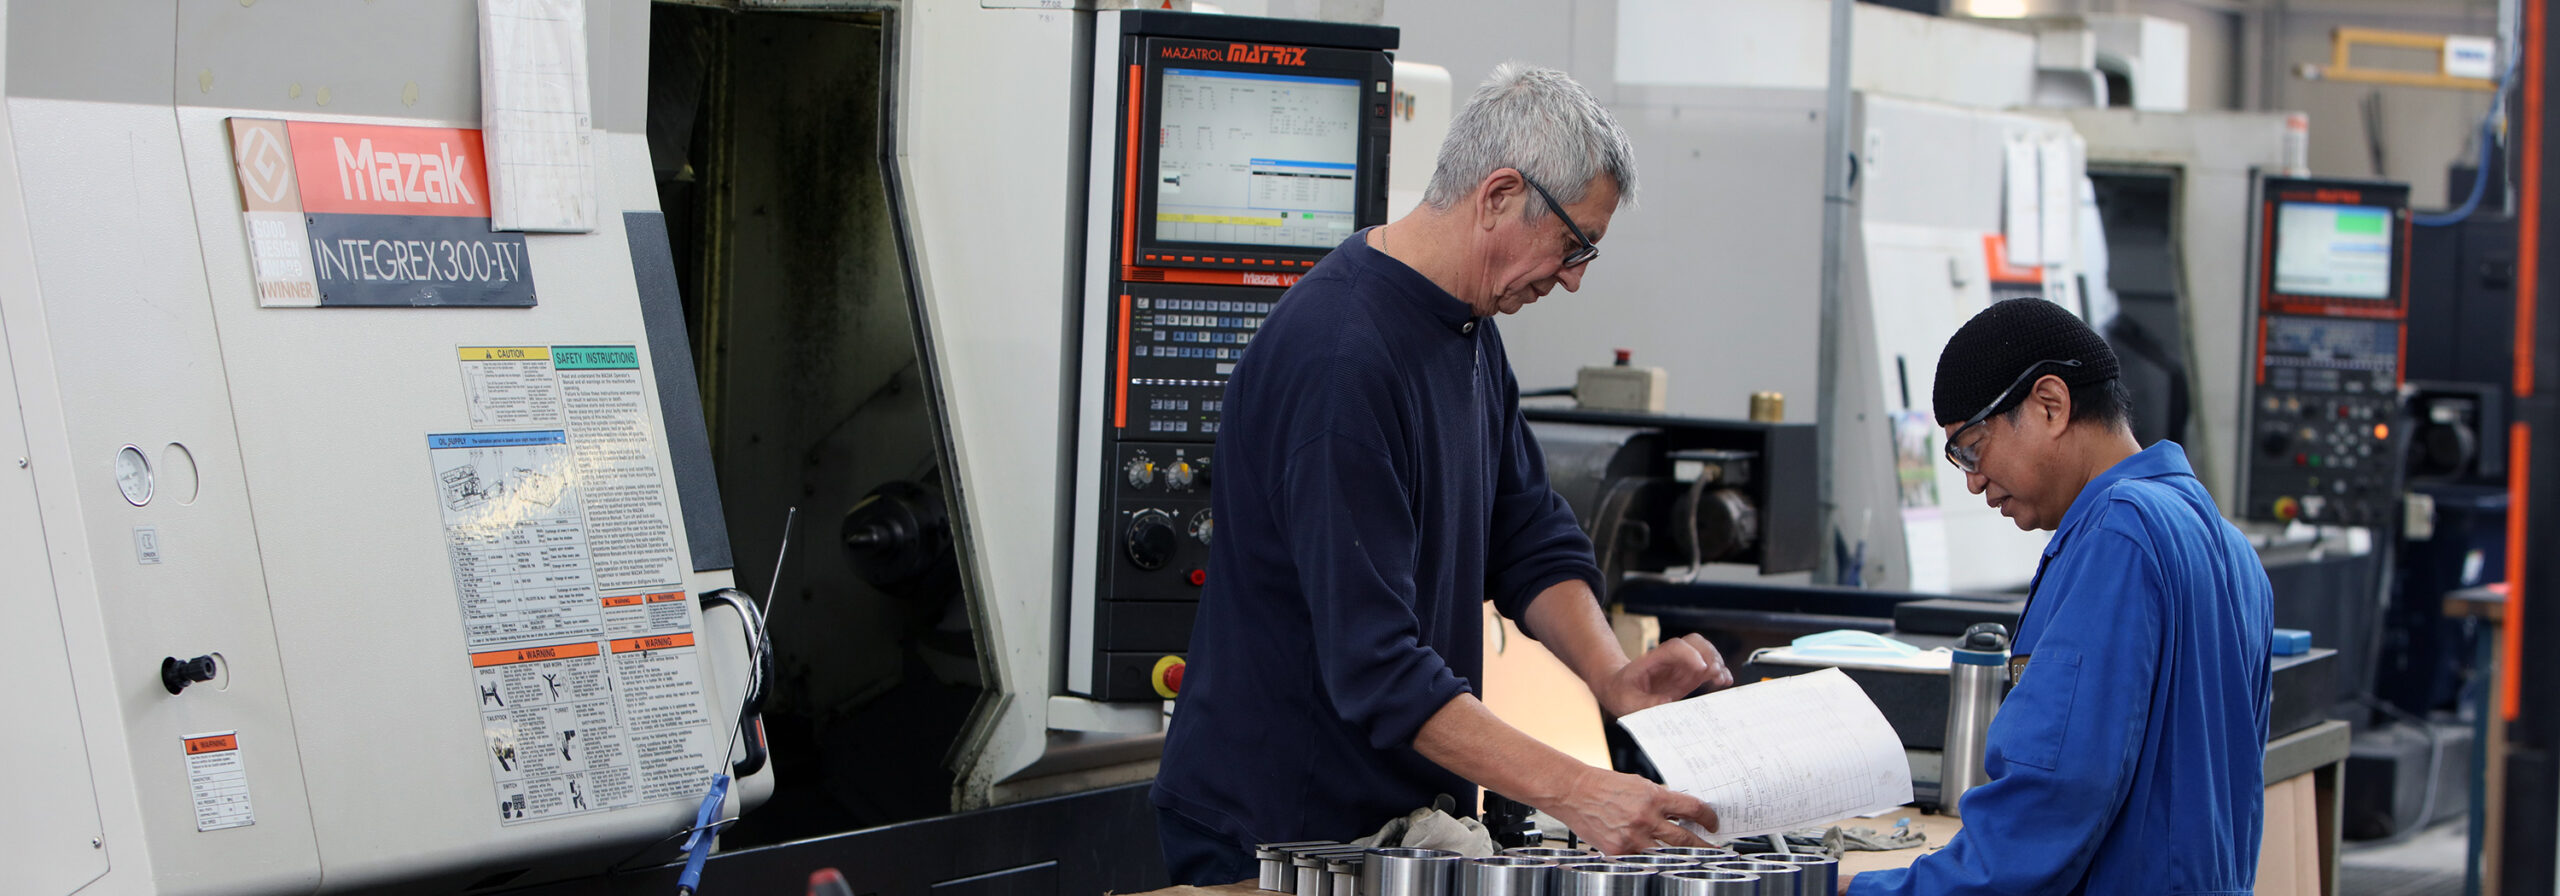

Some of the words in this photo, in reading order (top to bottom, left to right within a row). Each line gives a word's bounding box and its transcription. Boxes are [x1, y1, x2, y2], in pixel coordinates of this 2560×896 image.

[1161, 47, 1223, 61] MAZATROL
[1227, 43, 1307, 66] MATRIX
[333, 137, 475, 204] Mazak
[255, 221, 286, 238] GOOD
[257, 240, 300, 257] DESIGN
[1243, 272, 1279, 286] Mazak
[265, 282, 314, 298] WINNER
[497, 350, 525, 358] CAUTION
[556, 352, 582, 364] SAFETY
[586, 352, 635, 364] INSTRUCTIONS
[644, 637, 672, 646] WARNING
[525, 648, 555, 658] WARNING
[200, 739, 227, 747] WARNING
